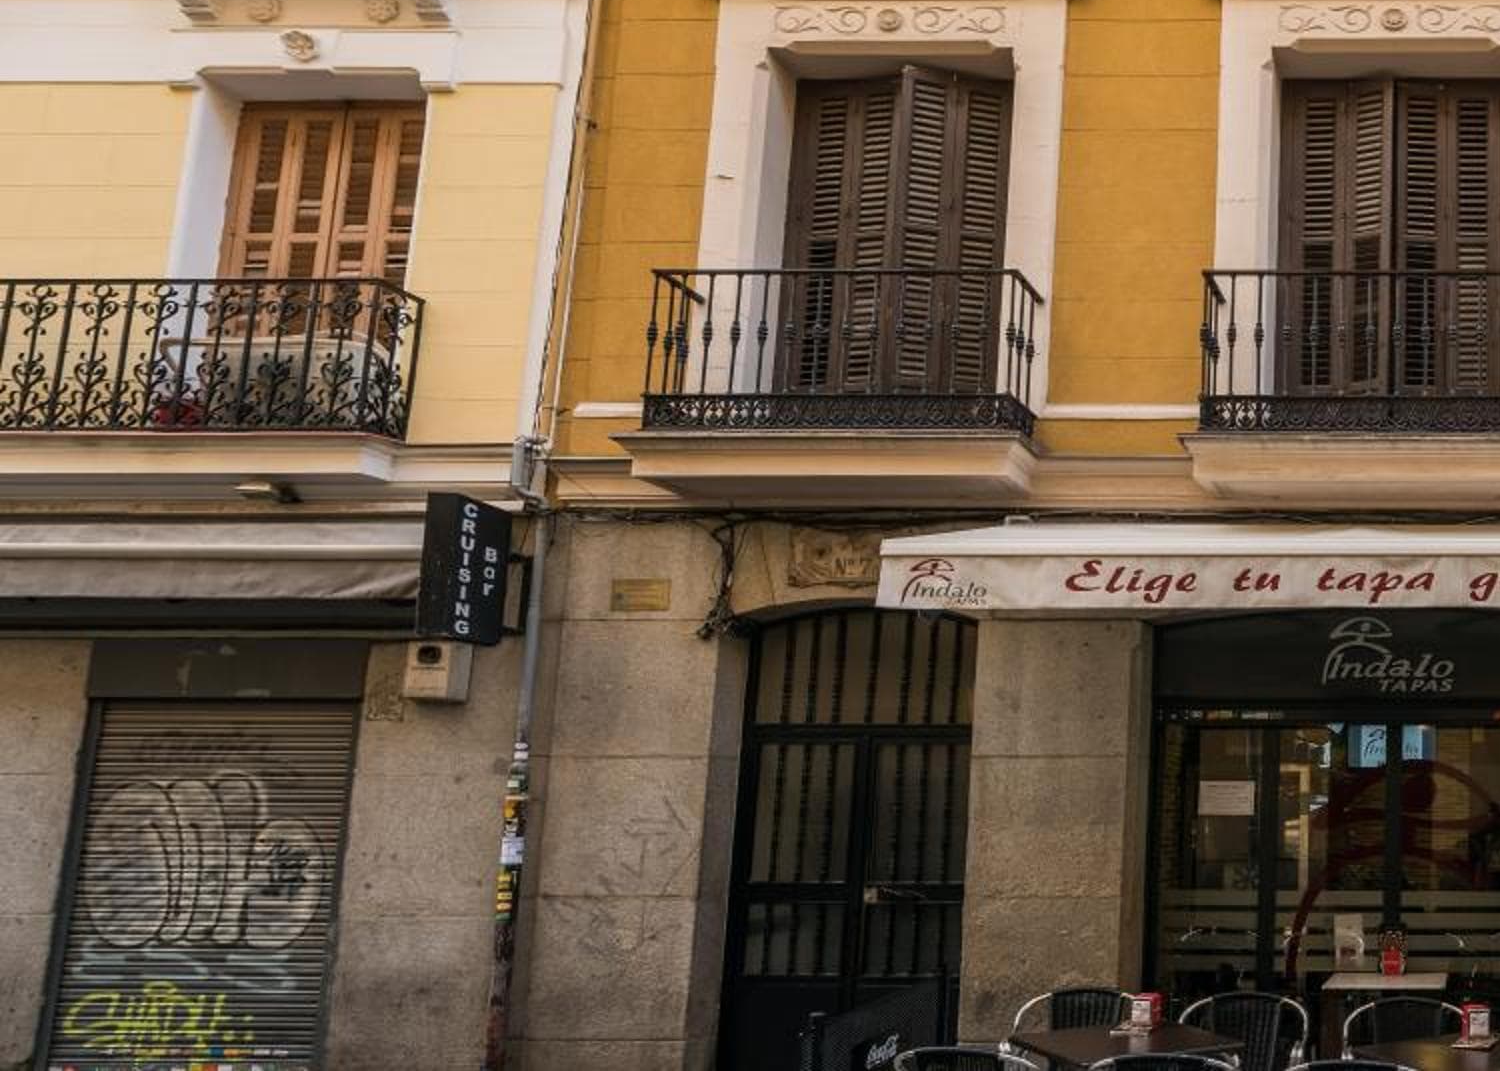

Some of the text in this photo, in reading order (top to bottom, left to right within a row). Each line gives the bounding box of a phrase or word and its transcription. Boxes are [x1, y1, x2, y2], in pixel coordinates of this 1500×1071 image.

[454, 502, 479, 634] CRUISING
[482, 546, 498, 597] Bar
[1065, 559, 1197, 604] Elige
[1233, 567, 1281, 593] tu
[1316, 567, 1435, 604] tapa
[911, 582, 987, 598] Indalo
[1327, 653, 1455, 679] Indalo
[1378, 678, 1454, 692] TAPAS
